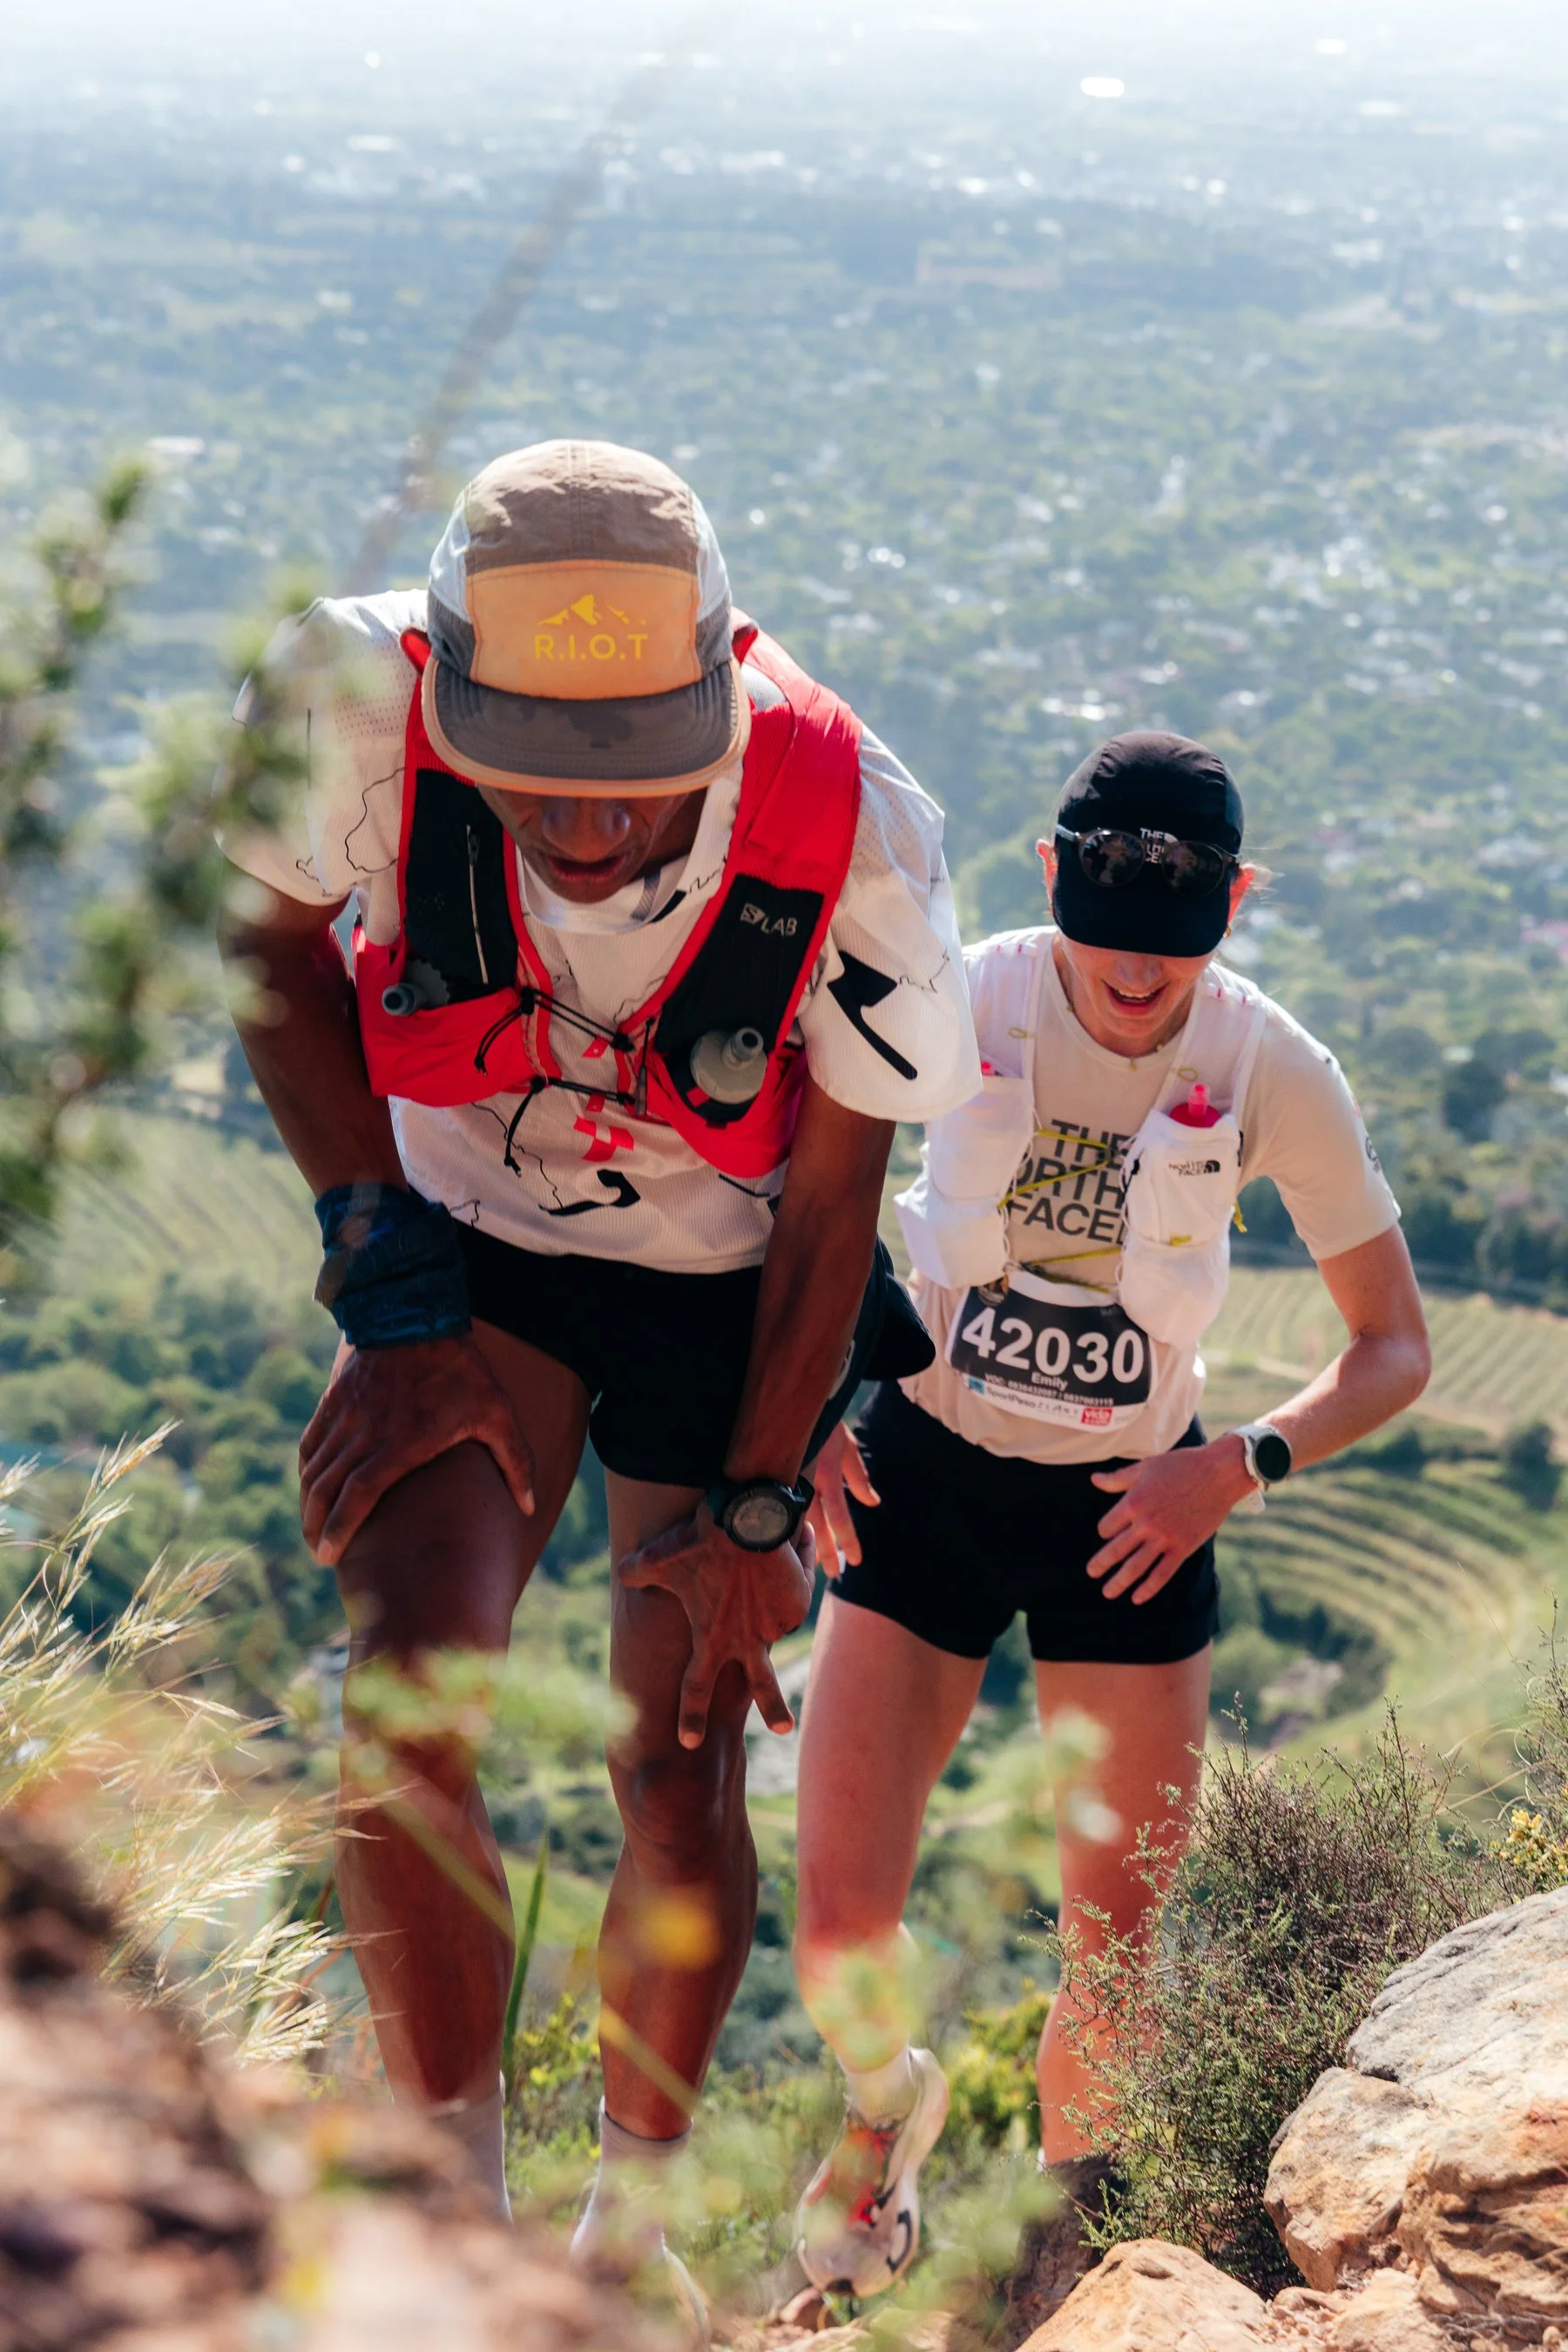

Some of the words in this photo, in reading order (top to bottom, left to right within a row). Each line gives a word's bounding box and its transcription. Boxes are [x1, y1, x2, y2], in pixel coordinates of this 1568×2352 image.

[534, 633, 648, 660] R.I.O.T
[1051, 1119, 1131, 1171] THE
[1010, 1152, 1125, 1210] ORTH
[961, 1307, 1144, 1383] 42030
[1031, 1371, 1069, 1391] Emily
